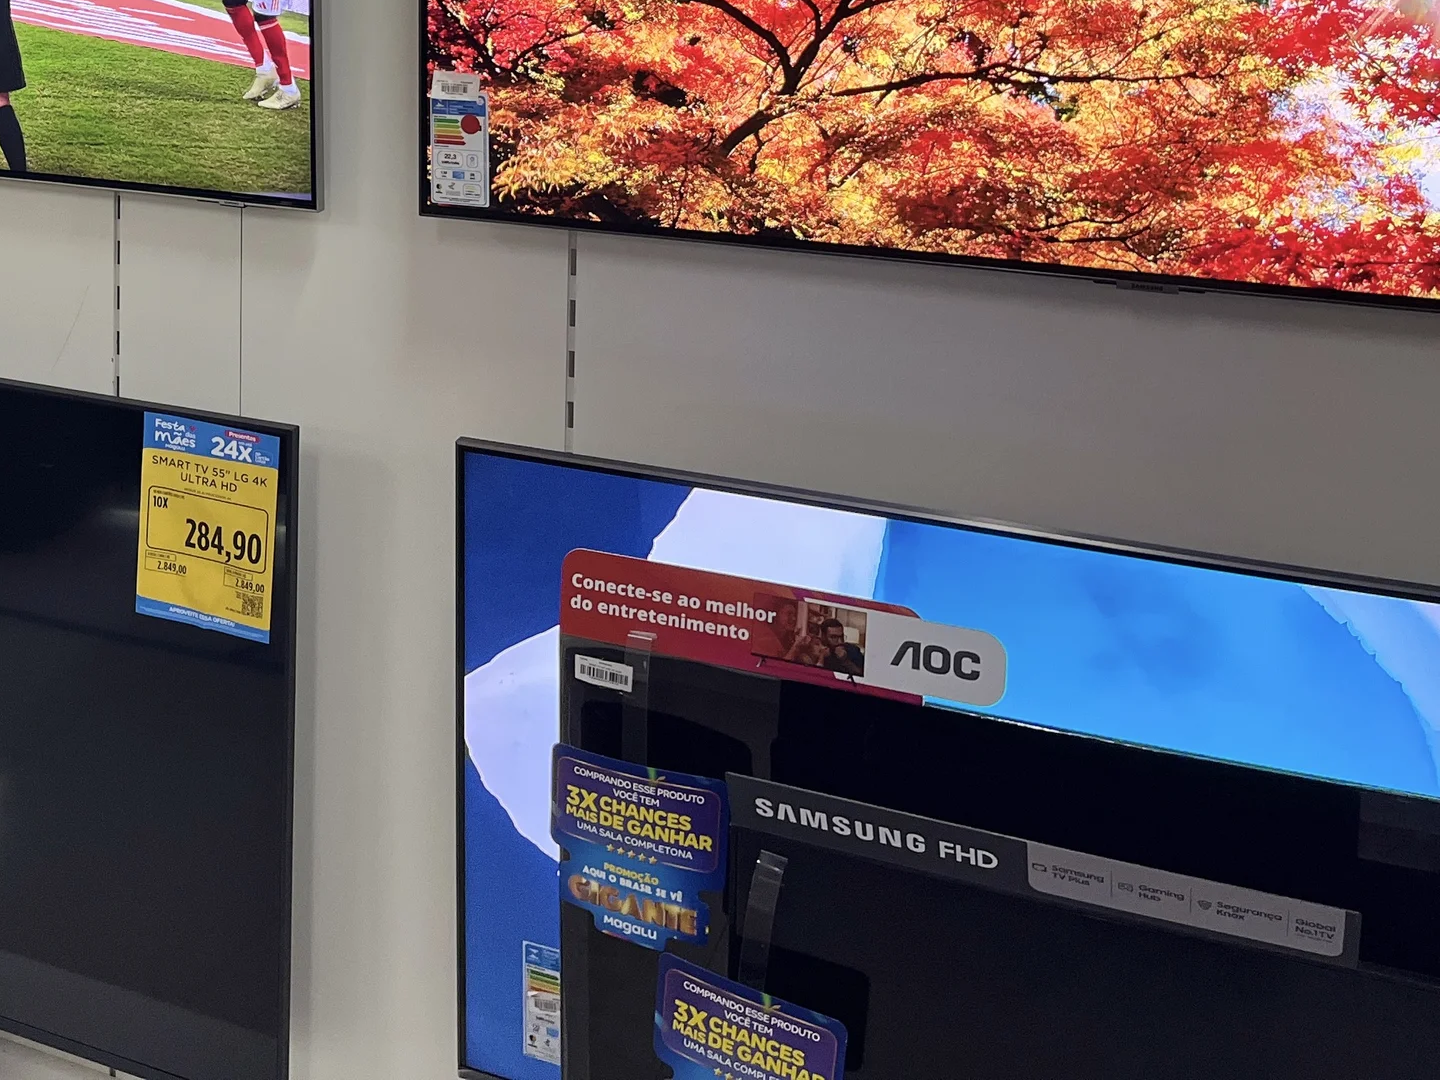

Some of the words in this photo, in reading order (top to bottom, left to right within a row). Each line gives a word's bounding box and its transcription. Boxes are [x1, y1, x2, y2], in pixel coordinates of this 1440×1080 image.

[155, 418, 186, 433] Festa
[155, 430, 196, 448] mães
[152, 455, 191, 470] SMART
[195, 463, 209, 475] TV
[234, 472, 249, 483] LG
[253, 476, 268, 488] 4K
[180, 472, 217, 489] ULTRA
[221, 482, 238, 493] HD
[153, 495, 169, 509] 10X
[185, 518, 261, 565] 284,90
[157, 561, 187, 575] 2.849,00
[235, 578, 265, 593] 2.849,00
[570, 573, 674, 605] Conecte-se
[677, 592, 702, 610] ao
[705, 594, 777, 624] melhor
[569, 594, 594, 613] do
[597, 601, 751, 642] entretenimento
[889, 640, 982, 682] AOC
[573, 766, 632, 790] COMPRANDO
[632, 782, 657, 796] ESSE
[657, 787, 705, 805] PRODUTO
[613, 788, 639, 803] VOCÊ
[640, 796, 660, 808] TEM
[566, 784, 598, 812] 3X
[599, 795, 692, 831] CHANCES
[566, 804, 598, 823] MAIS
[599, 811, 625, 832] DE
[626, 819, 713, 852] GANHAR
[576, 820, 598, 836] UMA
[599, 828, 624, 843] SALA
[624, 835, 693, 861] COMPLETONA
[754, 797, 927, 853] SAMSUNG
[937, 839, 999, 870] FHD
[582, 865, 606, 880] AQUI
[609, 873, 616, 883] O
[619, 877, 653, 895] BRASIL
[656, 888, 667, 899] SE
[603, 862, 659, 885] PROMOÇÃO
[1051, 864, 1105, 884] Samsung
[1052, 872, 1066, 881] TV
[1069, 876, 1090, 886] Plus
[567, 874, 698, 936] GIGANTE
[1138, 884, 1185, 901] Gaming
[1139, 892, 1161, 902] Hub
[1216, 901, 1283, 921] Segurança
[1216, 909, 1245, 921] Knox
[603, 914, 658, 940] Magalu
[1295, 918, 1337, 933] Global
[683, 980, 745, 1013] COMPRANDO
[745, 1006, 770, 1023] ESSE
[770, 1016, 821, 1043] PRODUTO
[724, 1009, 751, 1028] VOCÊ
[751, 1020, 774, 1037] TEM
[672, 1018, 707, 1044] MAIS
[707, 1031, 734, 1056] DE
[673, 998, 708, 1033] 3X
[709, 1016, 805, 1067] CHANCES
[683, 1038, 706, 1057] UMA
[706, 1049, 733, 1068] SALA
